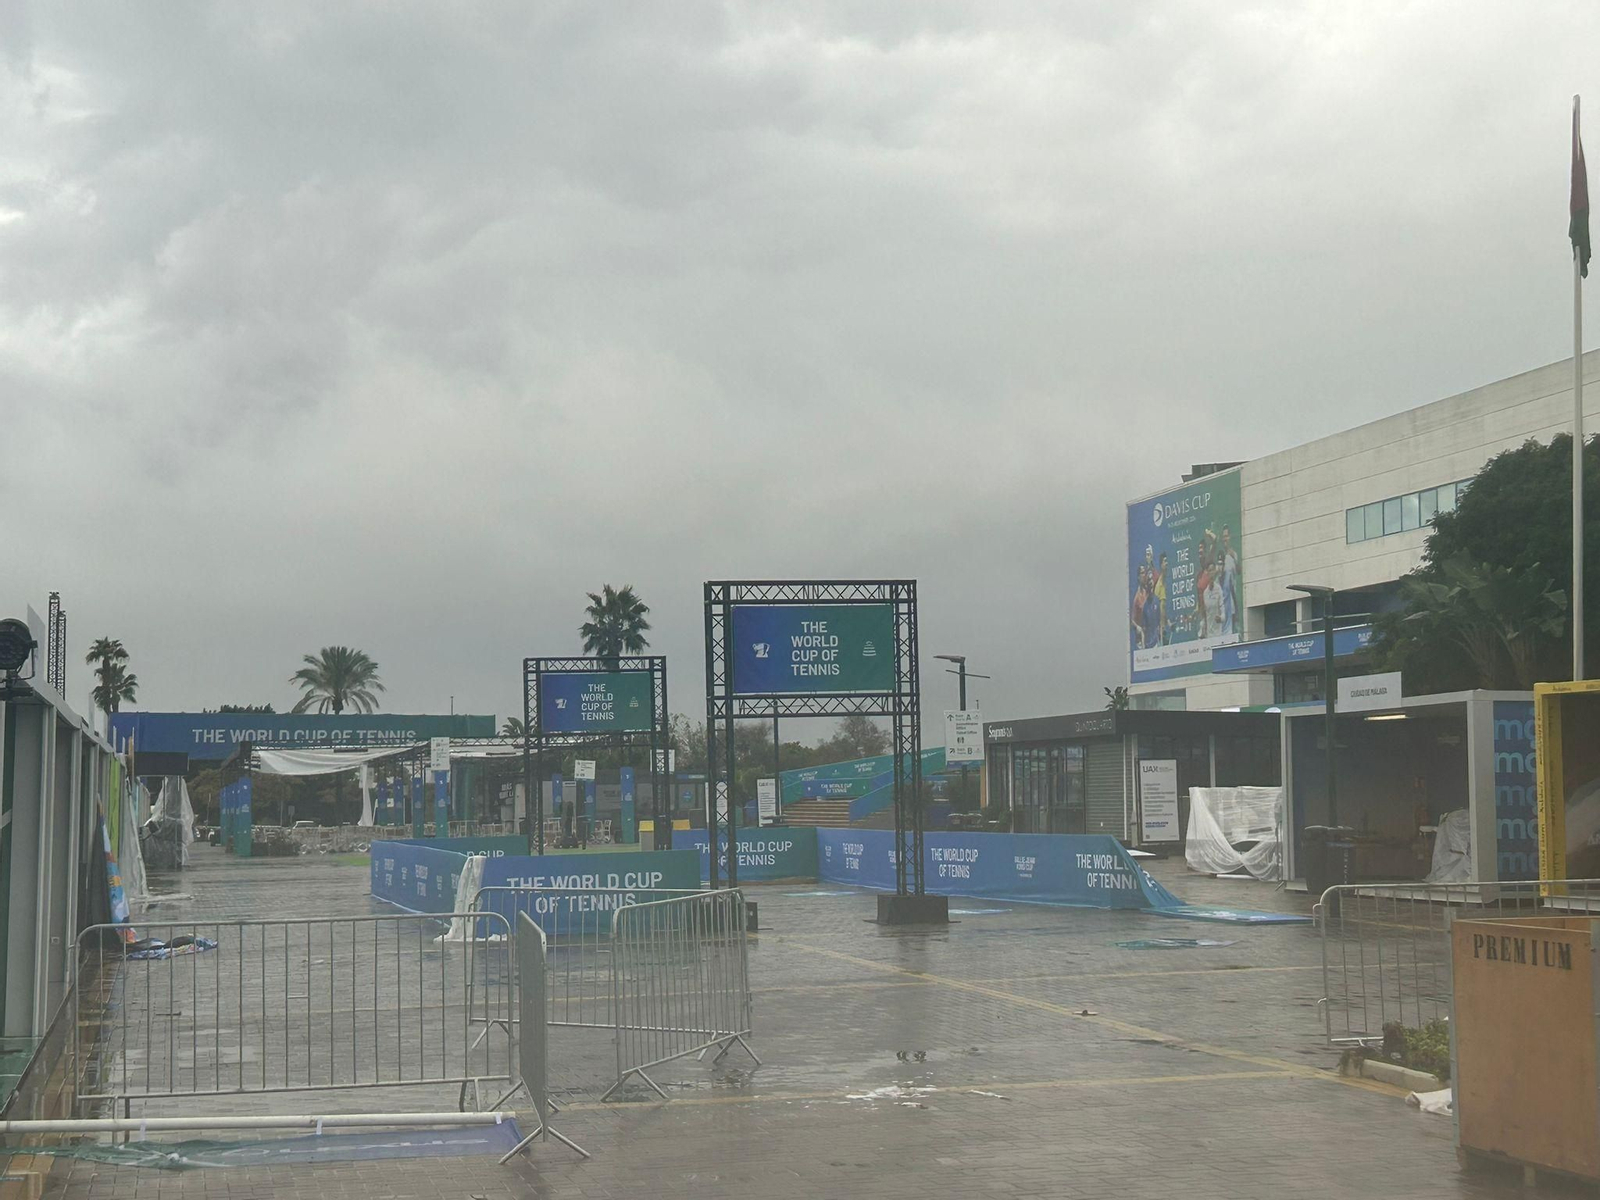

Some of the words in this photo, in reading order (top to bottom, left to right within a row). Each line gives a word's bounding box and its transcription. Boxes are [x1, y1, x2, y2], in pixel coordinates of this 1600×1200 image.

[1165, 498, 1190, 519] DAVIS
[1192, 492, 1211, 510] CUP
[1176, 547, 1190, 562] THE
[1171, 562, 1195, 580] WORLD
[1171, 580, 1185, 595] CUP
[1185, 578, 1195, 592] OF
[1171, 594, 1196, 611] TENNIS
[801, 621, 828, 633] THE
[790, 635, 839, 648] WORLD
[791, 650, 819, 662] CUP
[821, 649, 839, 661] OF
[790, 663, 841, 676] TENNIS
[588, 683, 606, 692] THE
[581, 693, 614, 702] WORLD
[581, 702, 600, 711] CUP
[601, 702, 613, 711] OF
[581, 711, 615, 721] TENNIS
[192, 729, 226, 743] THE
[230, 729, 290, 743] WORLD
[294, 730, 327, 743] CUP
[331, 730, 353, 743] OF
[356, 730, 418, 743] TENNIS
[967, 747, 973, 755] B
[1142, 765, 1158, 773] UAX
[694, 842, 711, 854] TH
[768, 840, 793, 853] CUP
[930, 848, 943, 861] THE
[943, 848, 965, 862] WORLD
[965, 849, 979, 863] CUP
[1076, 853, 1092, 869] THE
[938, 864, 948, 877] OF
[948, 864, 970, 879] TENNIS
[506, 876, 546, 894] THE
[550, 873, 620, 890] WORLD
[624, 872, 663, 889] CUP
[1087, 872, 1098, 887] OF
[535, 898, 558, 914] OF
[565, 893, 637, 913] TENNIS
[1473, 933, 1573, 971] PREMIUM
